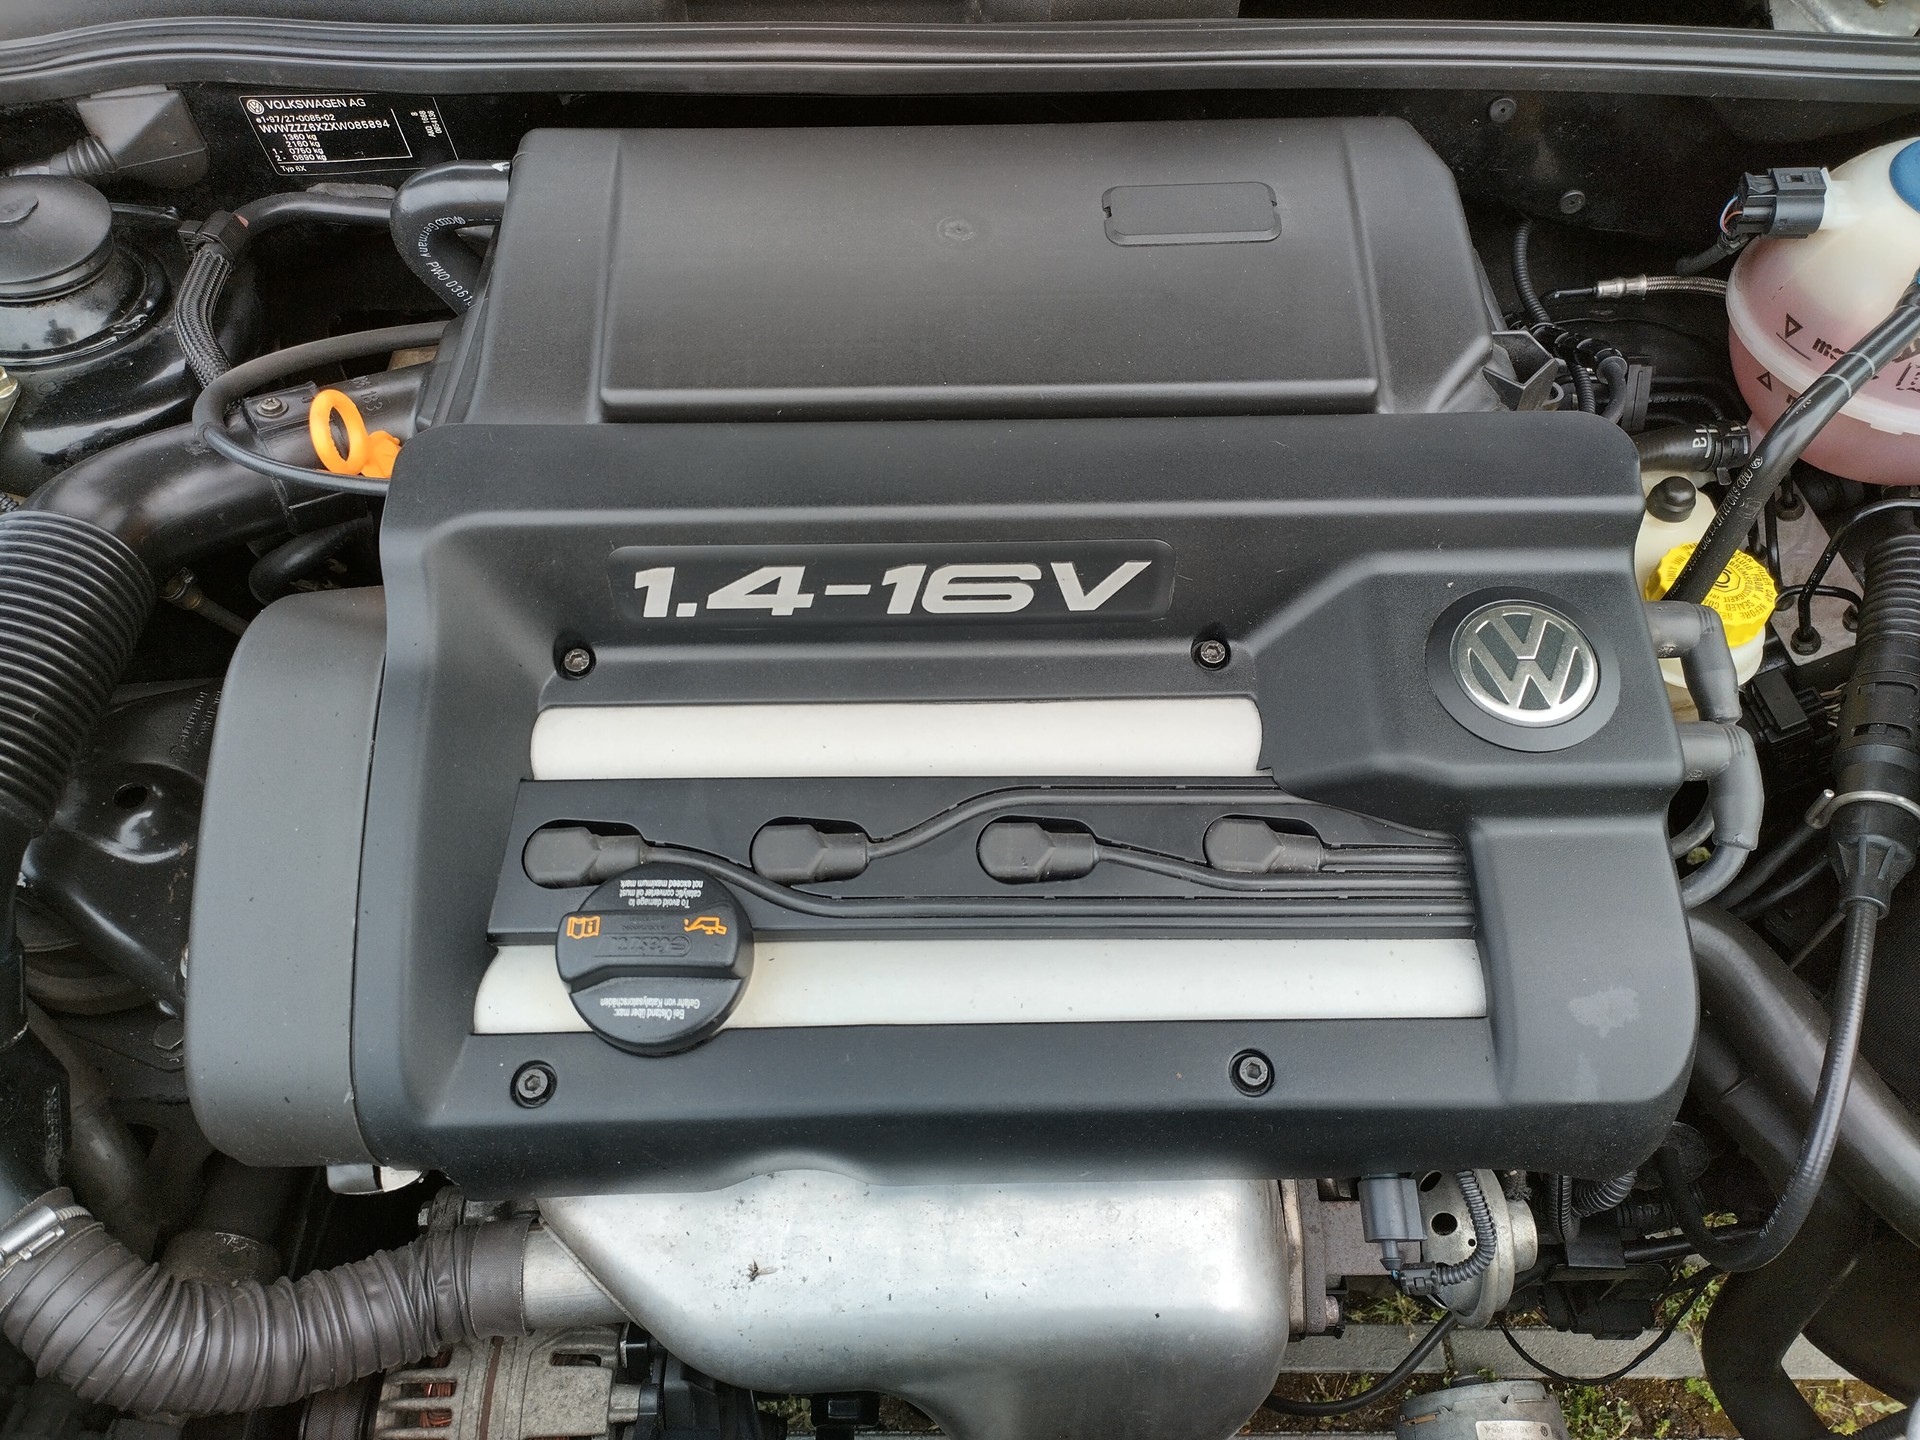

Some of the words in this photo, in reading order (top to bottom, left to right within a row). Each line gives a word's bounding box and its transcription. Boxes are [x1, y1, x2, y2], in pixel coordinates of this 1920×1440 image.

[264, 98, 347, 110] VOLKSWAGEN
[349, 98, 366, 107] AG
[258, 119, 390, 134] WVWZZZ6XZXW085894
[305, 133, 318, 141] kg
[309, 140, 321, 148] kg
[312, 147, 325, 155] kg
[280, 165, 295, 173] Typ
[417, 222, 440, 258] Germany
[634, 560, 1152, 618] 1.4-16V
[1724, 599, 1755, 613] SEALED
[637, 879, 668, 889] maximum
[668, 880, 692, 889] exceed
[692, 880, 704, 889] not
[619, 888, 636, 898] must
[644, 888, 675, 898] converter
[675, 888, 702, 899] catalytic
[636, 896, 662, 908] damage
[662, 898, 681, 908] avoid
[663, 998, 677, 1006] von
[677, 998, 701, 1009] Gefahr
[630, 1008, 646, 1019] über
[672, 1008, 685, 1020] Bei
